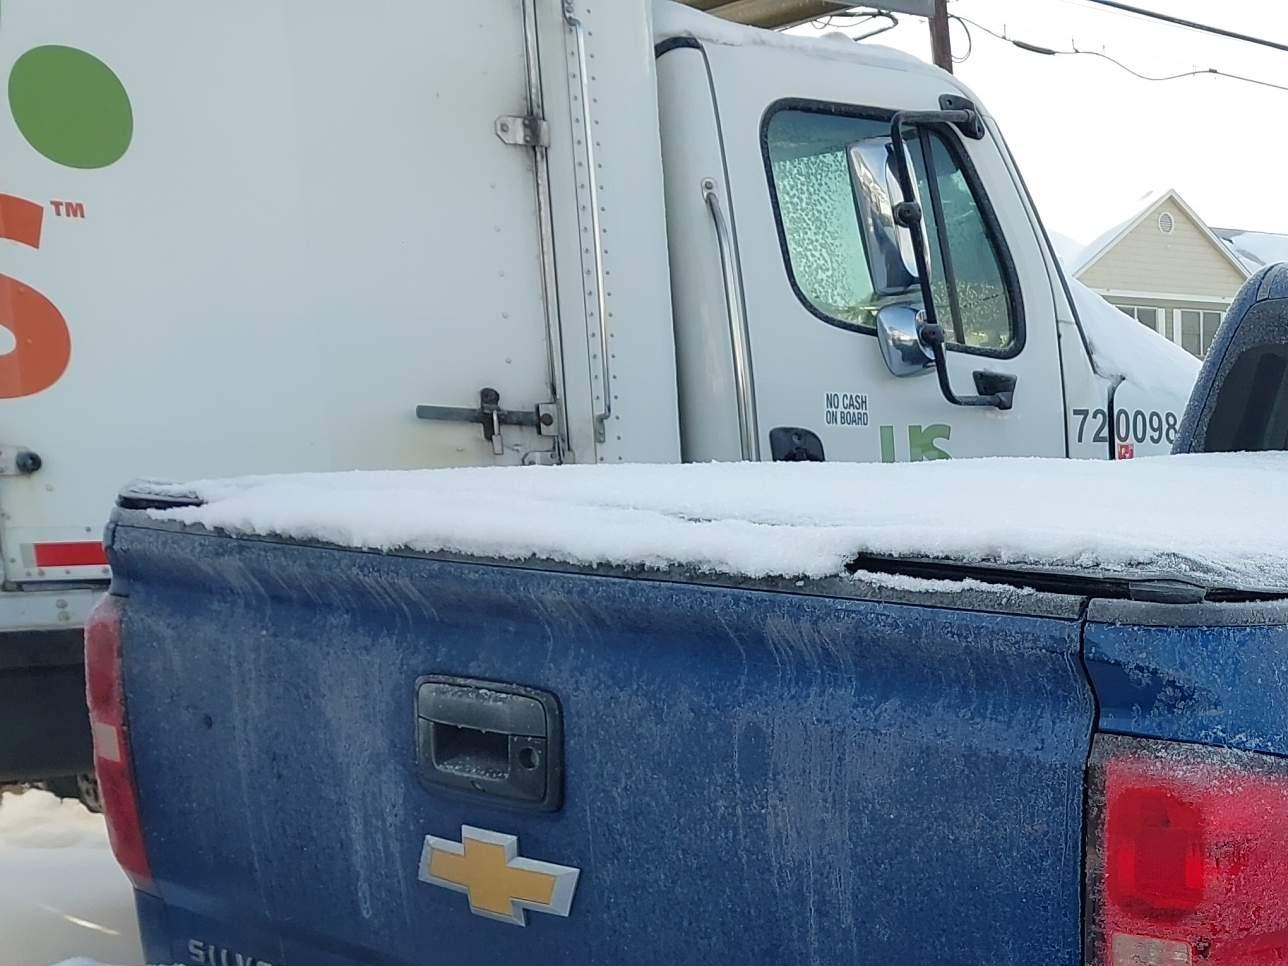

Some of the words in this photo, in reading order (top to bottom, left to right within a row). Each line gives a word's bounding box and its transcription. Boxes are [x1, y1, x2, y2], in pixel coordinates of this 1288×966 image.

[50, 200, 86, 219] TM
[826, 393, 839, 410] NO
[842, 394, 867, 411] CASH
[825, 410, 838, 425] ON
[840, 411, 869, 426] BOARD
[1072, 408, 1178, 445] 720098
